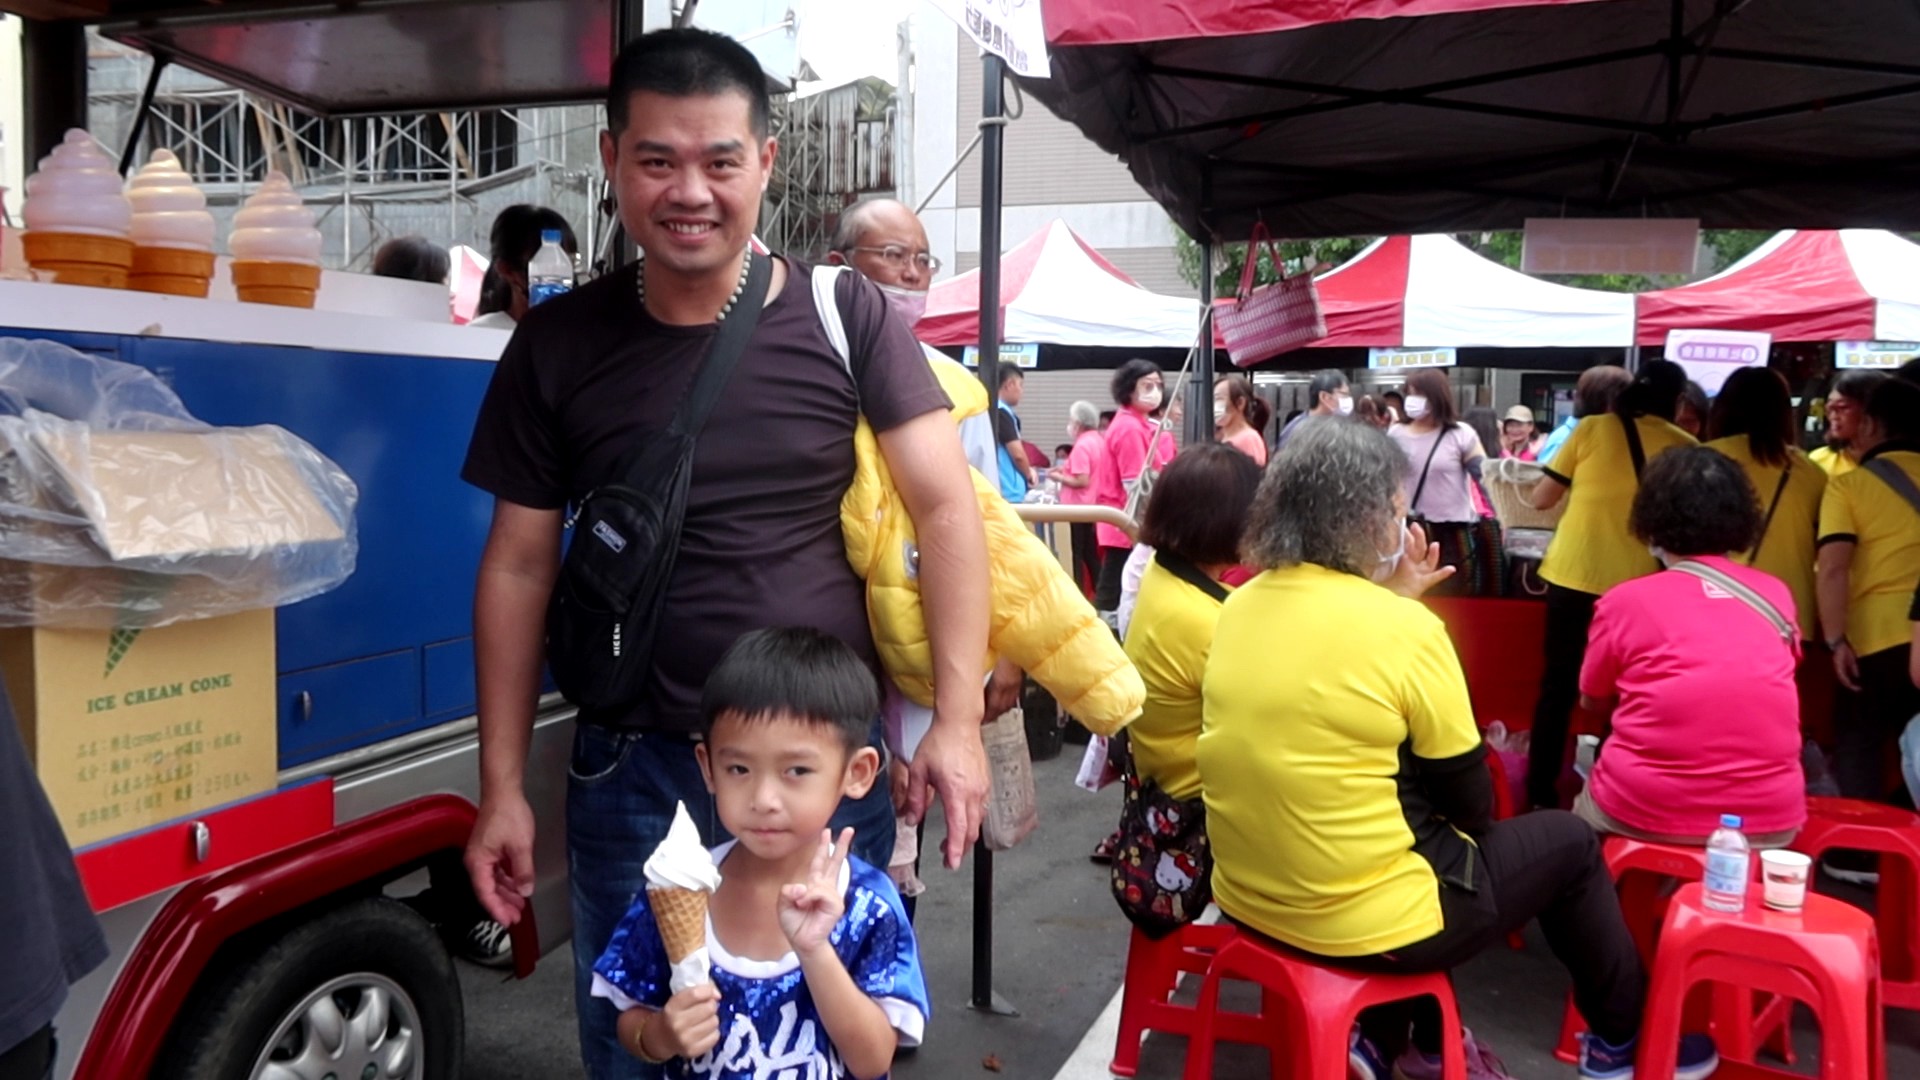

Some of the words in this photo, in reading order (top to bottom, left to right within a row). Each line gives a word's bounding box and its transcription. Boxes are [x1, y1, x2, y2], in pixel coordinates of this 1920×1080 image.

[87, 695, 116, 714] ICE
[124, 682, 183, 706] CREAM
[189, 673, 232, 693] CONE
